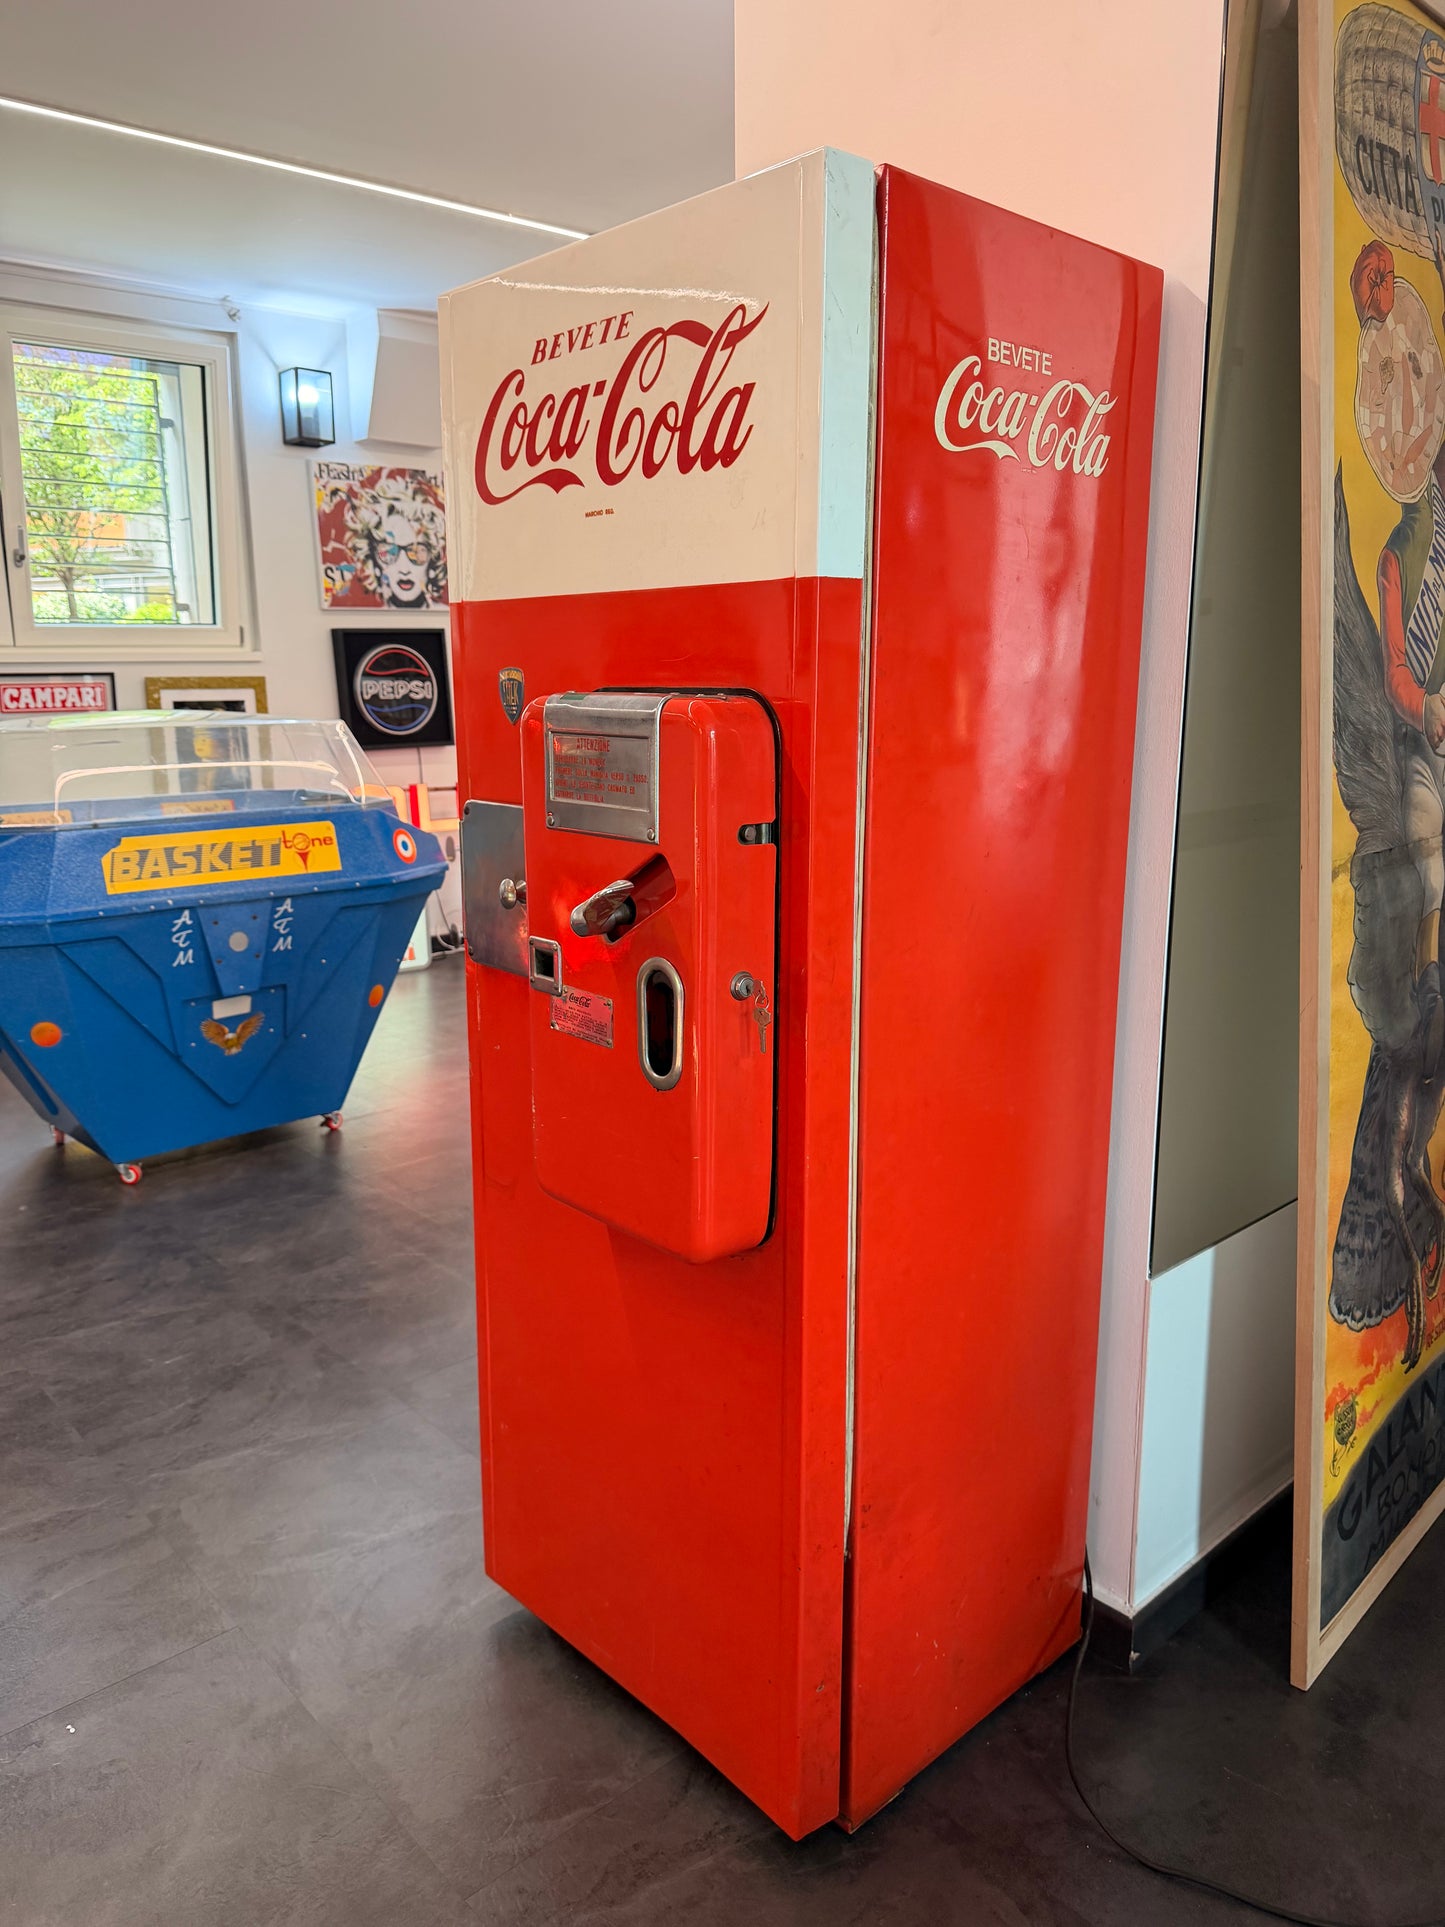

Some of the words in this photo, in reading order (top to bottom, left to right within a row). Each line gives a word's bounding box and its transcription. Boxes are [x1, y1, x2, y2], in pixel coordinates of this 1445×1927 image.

[530, 310, 634, 365] BEVETE
[987, 337, 1053, 376] BEVETE
[475, 301, 769, 505] Coca-Cola
[934, 355, 1118, 478] Coca-Cola
[4, 686, 103, 709] CAMPARI
[362, 680, 433, 700] PEPSI
[110, 838, 282, 882] BASKET
[1336, 1362, 1445, 1542] GALAN
